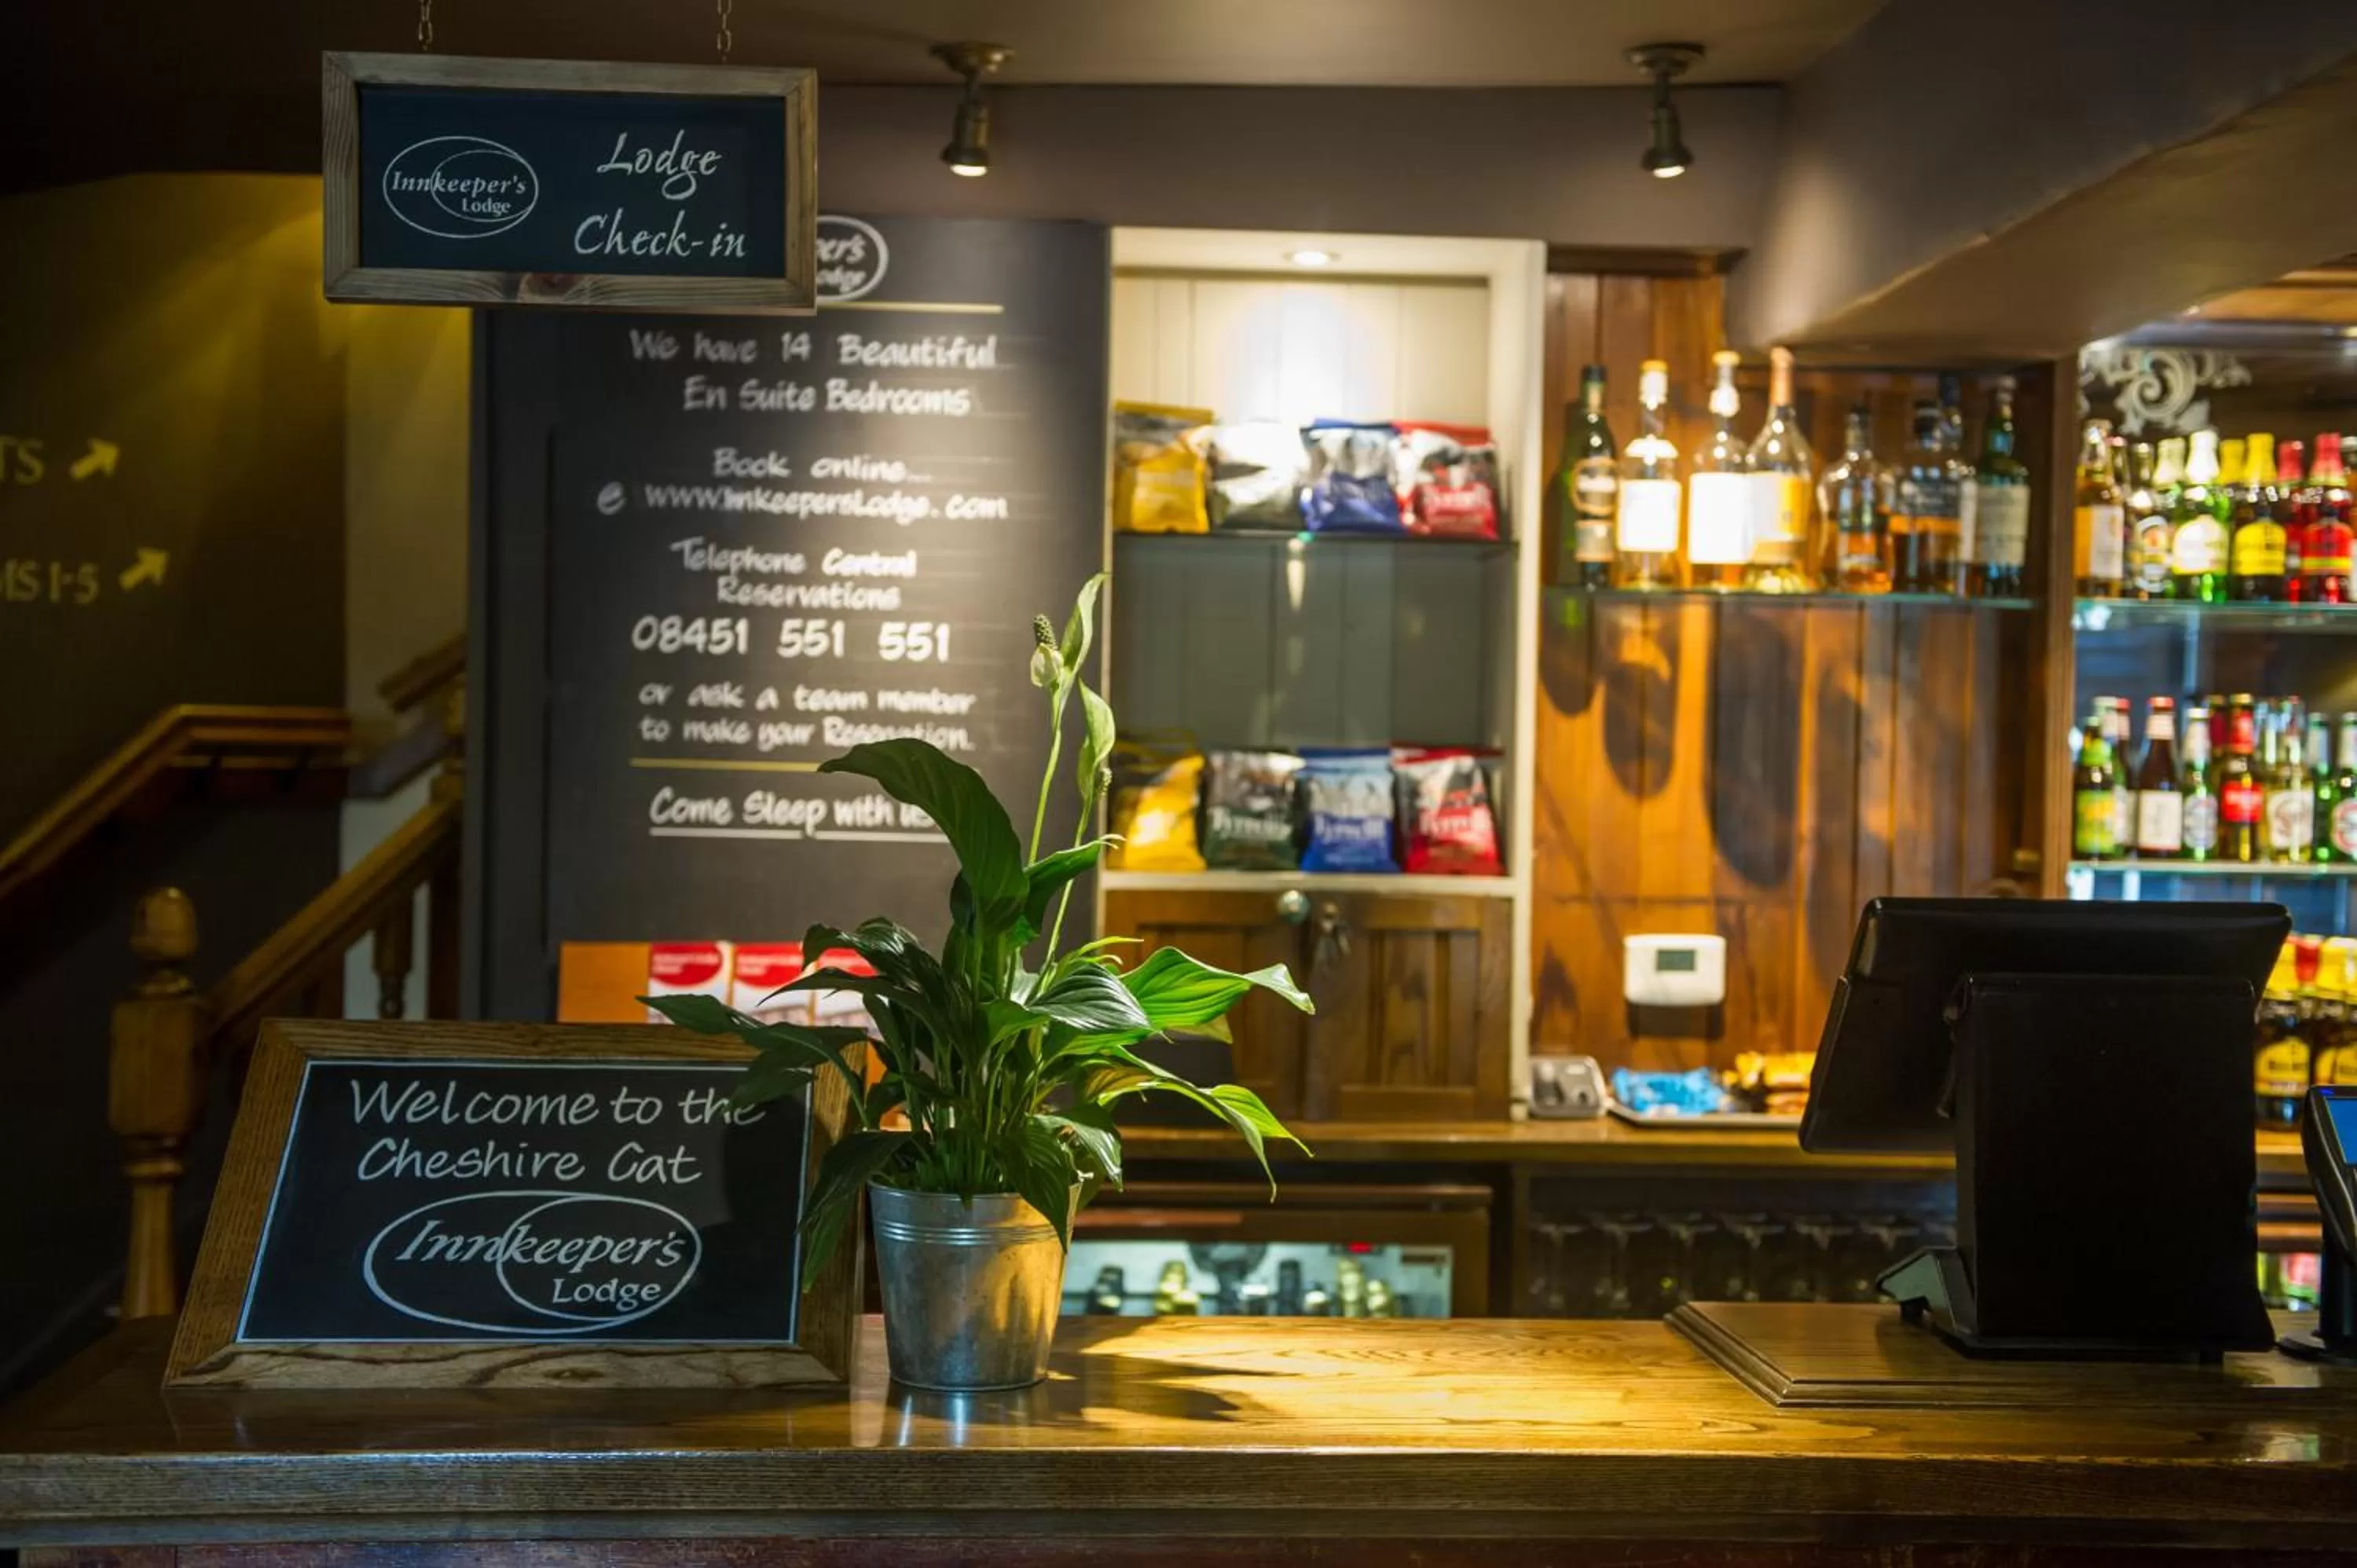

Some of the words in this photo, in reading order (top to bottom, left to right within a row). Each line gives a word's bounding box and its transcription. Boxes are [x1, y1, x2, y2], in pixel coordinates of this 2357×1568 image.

[392, 170, 526, 198] Innkeeper's
[596, 129, 721, 200] Lodge
[461, 196, 511, 217] Lodge
[574, 209, 746, 258] Check-in
[629, 328, 679, 360] We
[694, 331, 757, 362] have
[781, 332, 812, 361] 14
[838, 333, 999, 368] Beautiful
[683, 375, 727, 410] En
[739, 378, 816, 412] Suite
[825, 377, 971, 417] Bedrooms
[713, 446, 792, 478] Book
[669, 536, 807, 576] Telephone
[822, 546, 918, 578] Central
[717, 575, 902, 610] Reservations
[632, 615, 750, 655] 08451
[776, 617, 846, 659] 551
[878, 621, 951, 663] 551
[638, 683, 672, 705] or
[688, 680, 745, 710] ask
[793, 683, 869, 713] team
[878, 687, 977, 716] member
[638, 716, 671, 742] to
[683, 716, 753, 746] make
[757, 721, 816, 753] your
[649, 786, 734, 826] Come
[742, 789, 827, 837] Sleep
[833, 793, 896, 827] with
[350, 1077, 599, 1126] Welcome
[610, 1086, 662, 1125] to
[678, 1086, 767, 1126] the
[357, 1137, 586, 1181] Cheshire
[607, 1141, 704, 1184] Cat
[395, 1218, 686, 1273] Innkeeper's
[552, 1278, 662, 1311] Lodge
